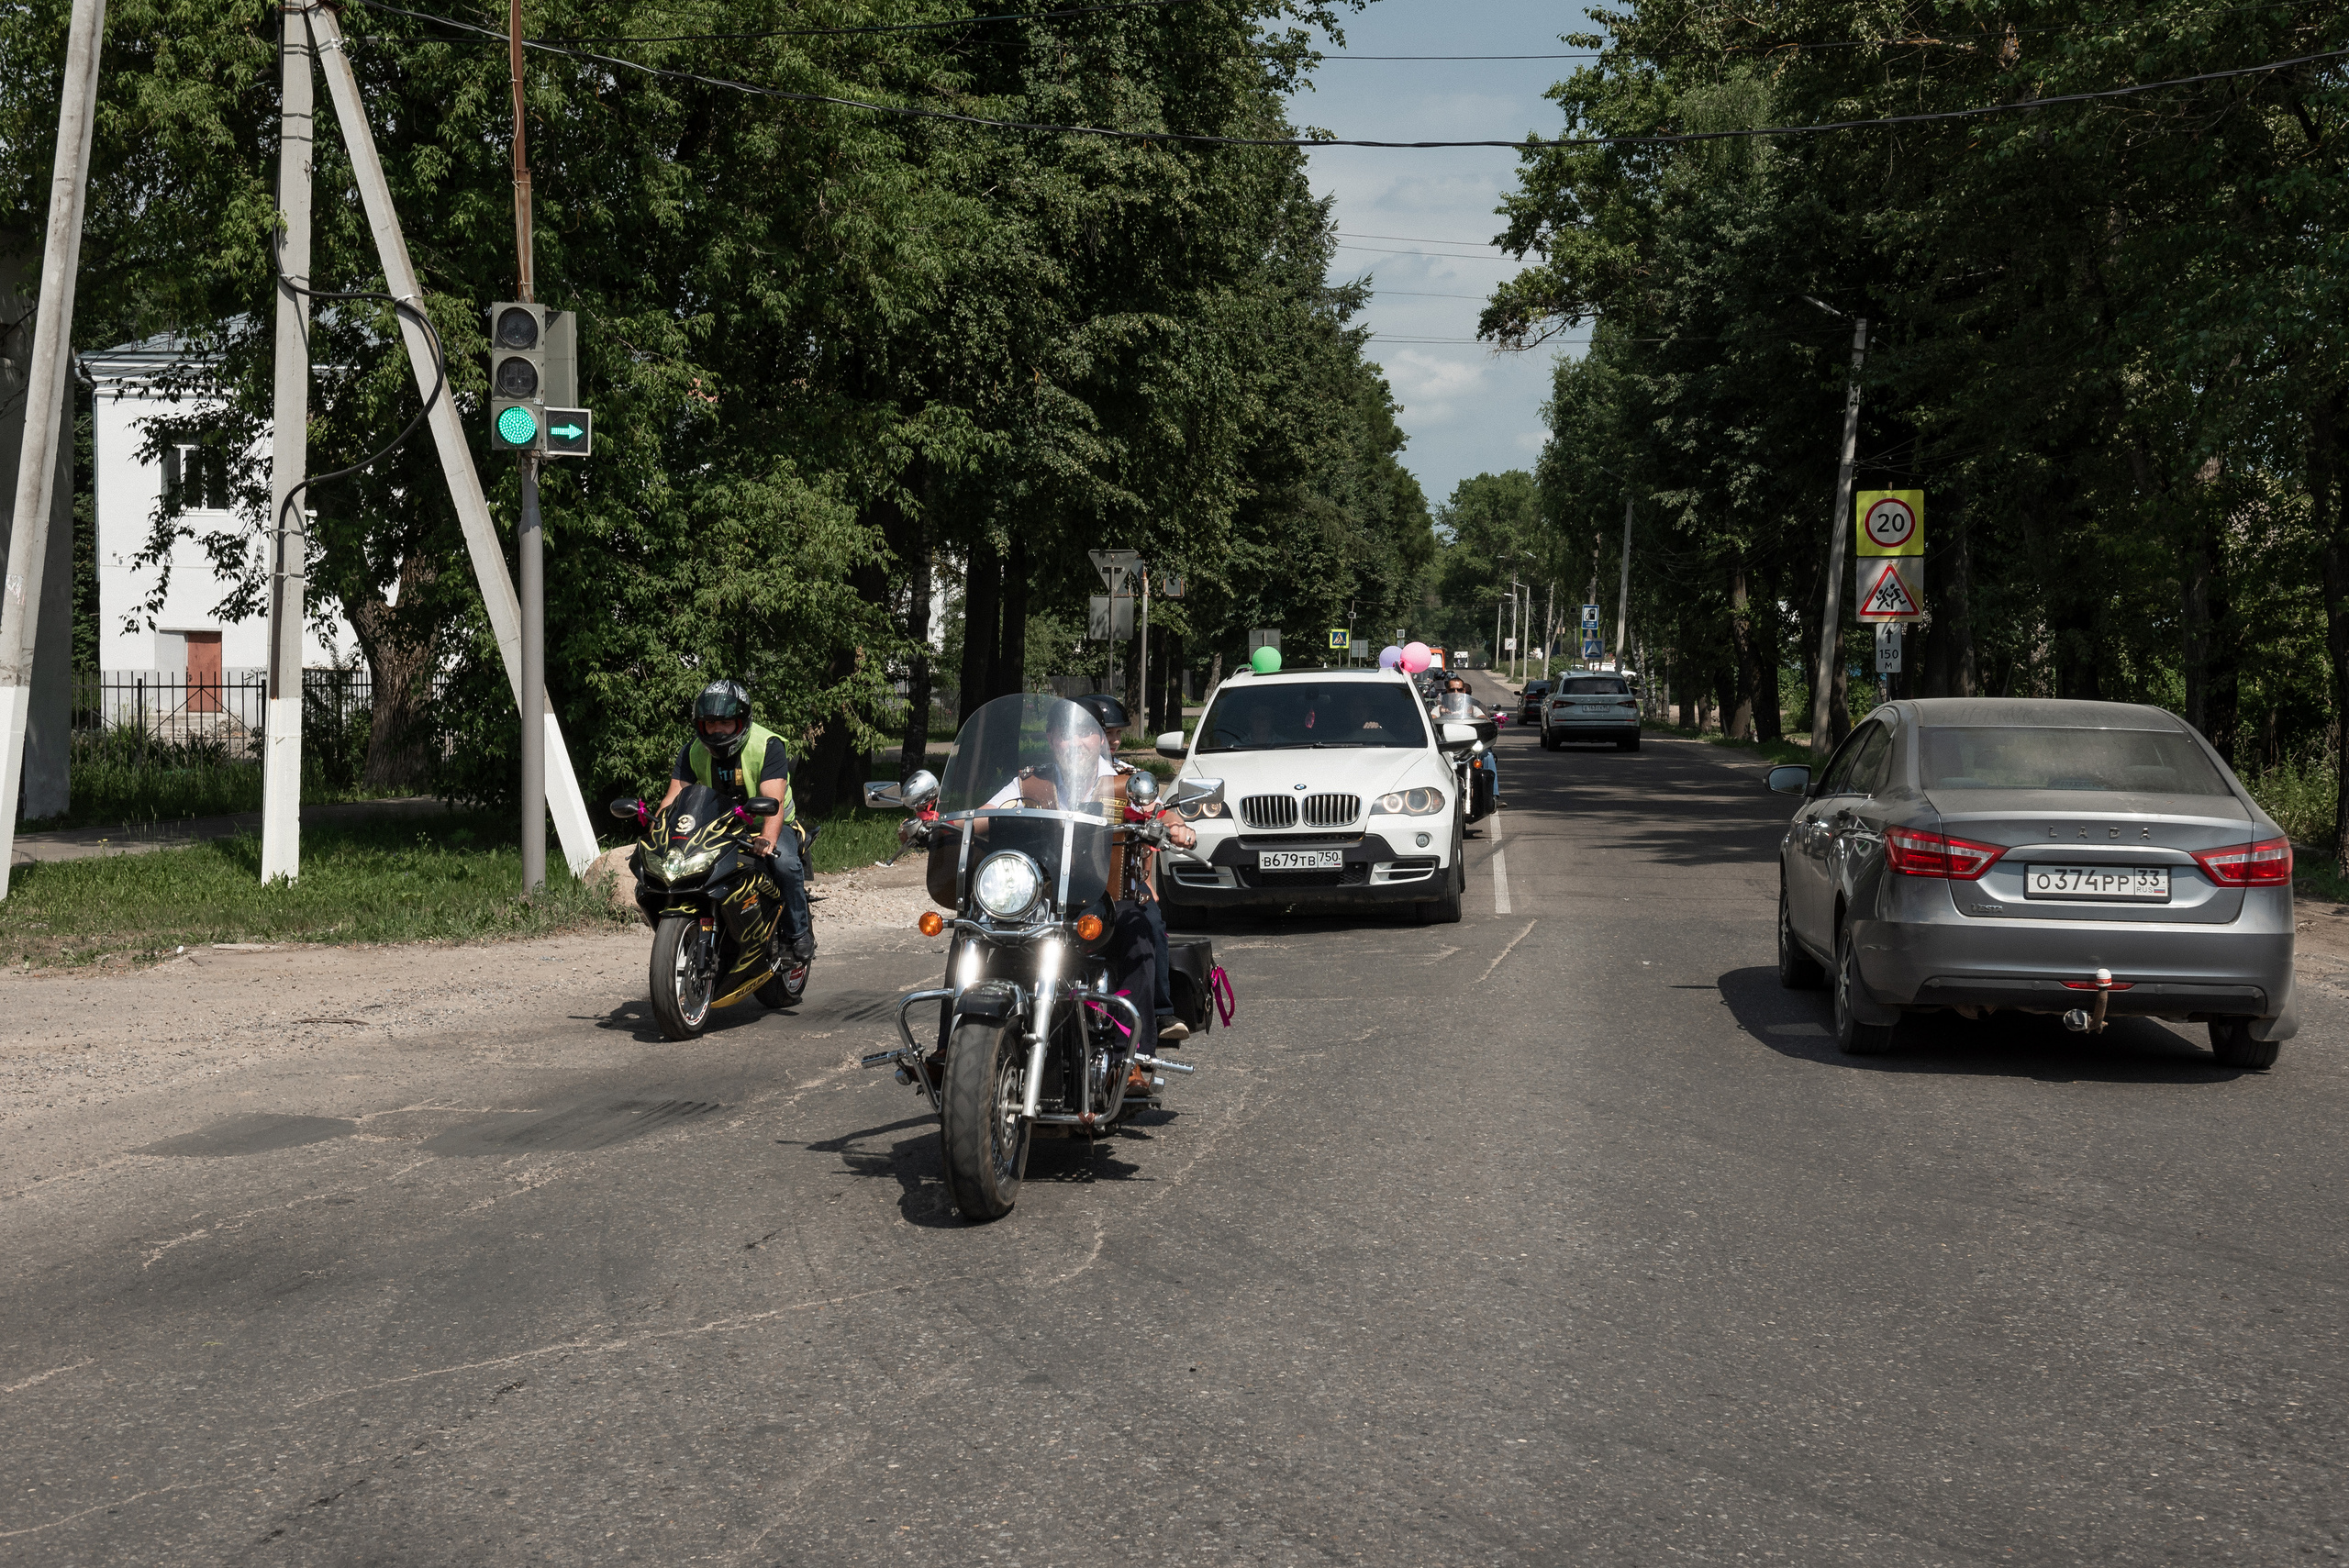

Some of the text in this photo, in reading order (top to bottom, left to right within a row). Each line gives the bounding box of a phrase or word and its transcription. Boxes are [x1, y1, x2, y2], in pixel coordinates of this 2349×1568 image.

[1876, 513, 1905, 533] 20
[1879, 649, 1899, 660] 150
[2049, 826, 2152, 840] LADA
[1318, 851, 1339, 862] 750
[2137, 869, 2160, 887] 33
